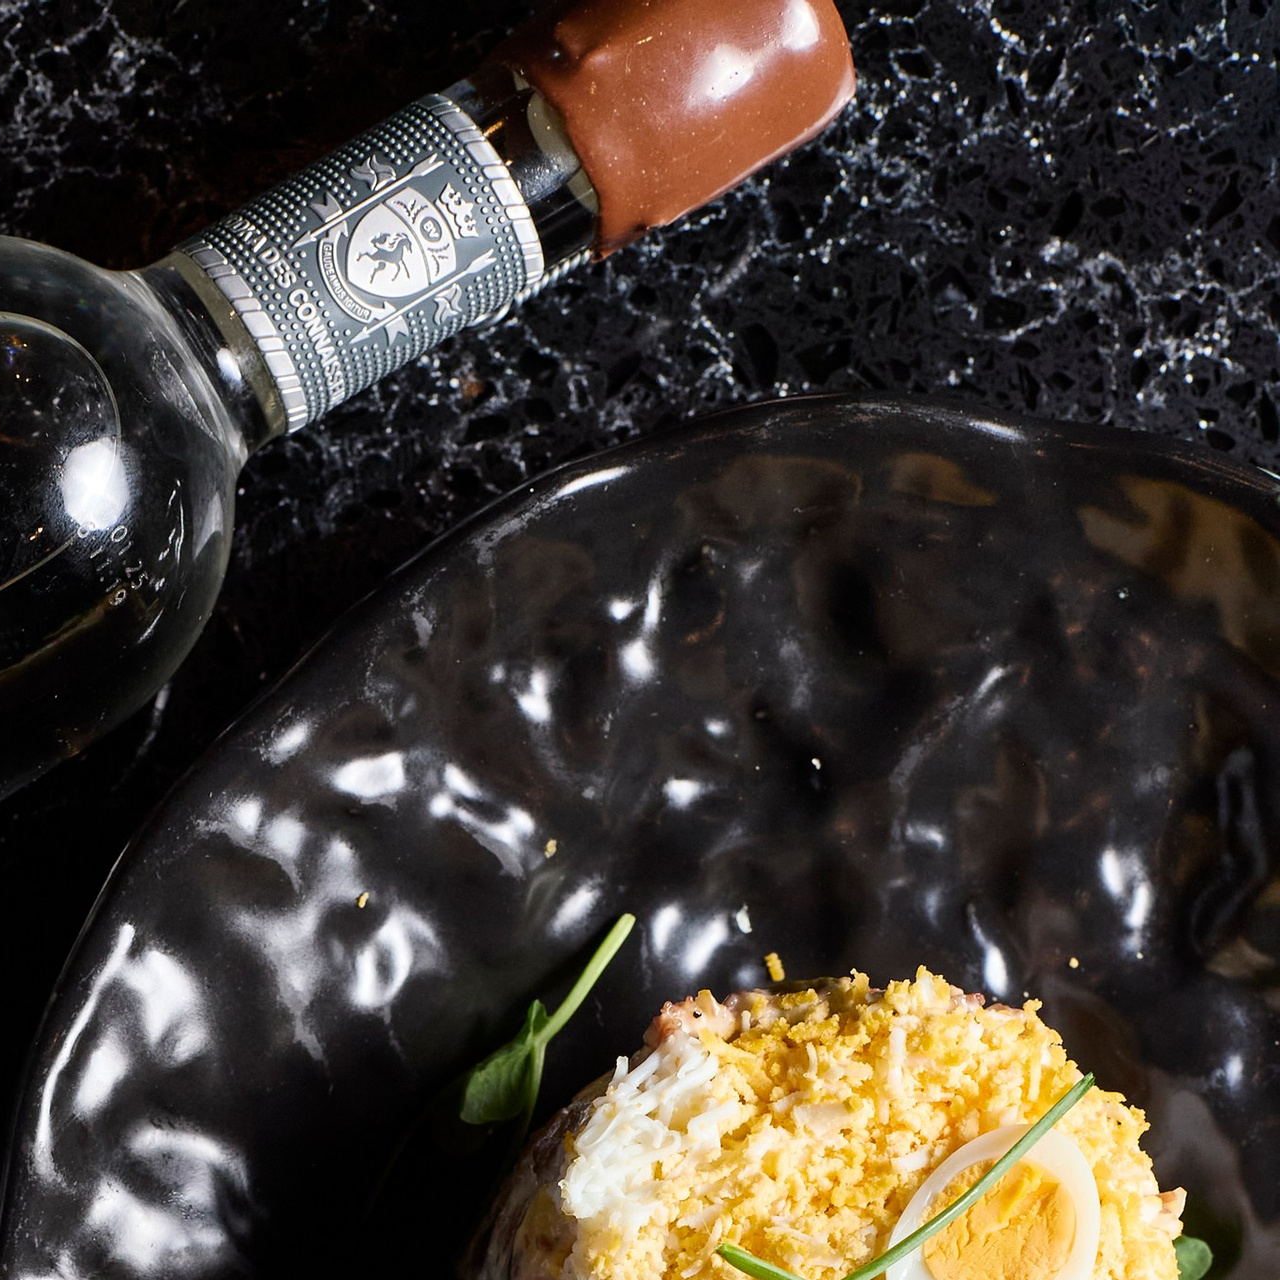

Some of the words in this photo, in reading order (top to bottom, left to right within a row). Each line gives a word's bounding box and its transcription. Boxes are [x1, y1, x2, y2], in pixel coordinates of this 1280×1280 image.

[423, 219, 439, 239] BV
[258, 246, 297, 289] DES
[323, 244, 346, 300] GAUDEAMUS
[344, 298, 370, 319] IGITUR
